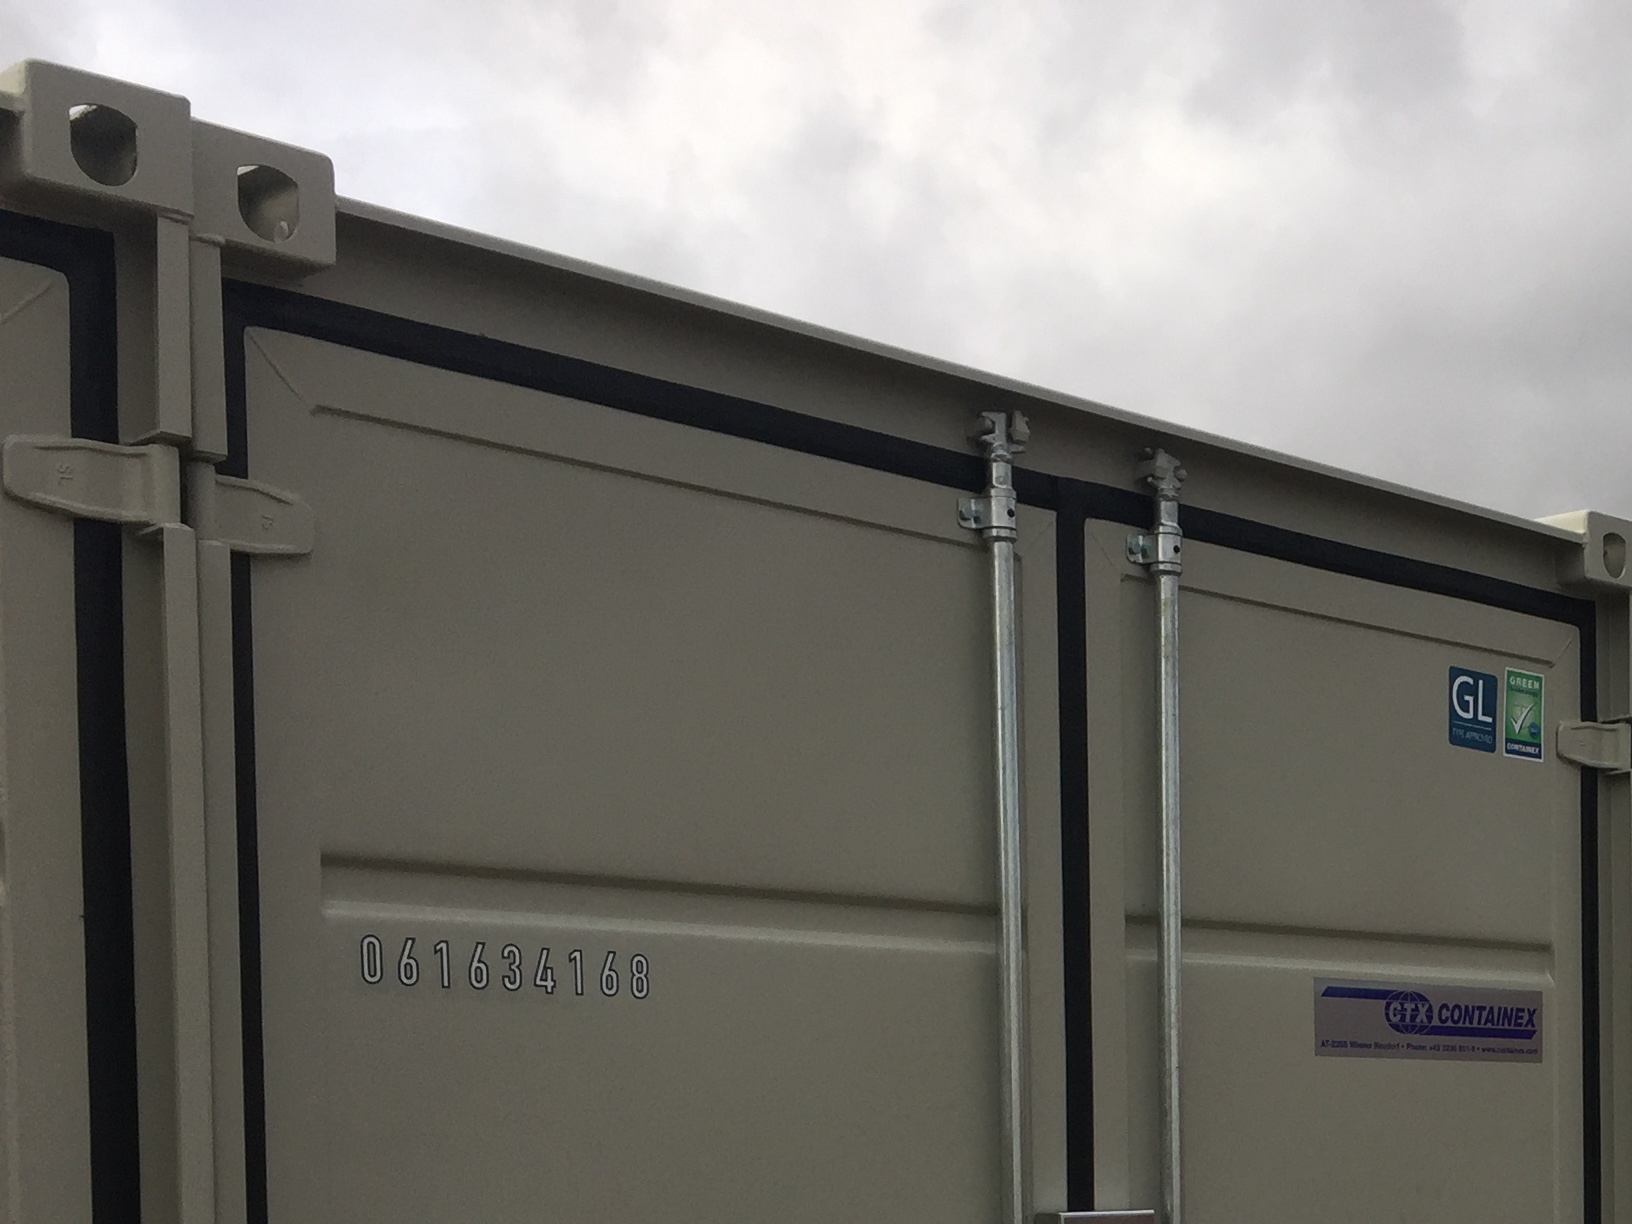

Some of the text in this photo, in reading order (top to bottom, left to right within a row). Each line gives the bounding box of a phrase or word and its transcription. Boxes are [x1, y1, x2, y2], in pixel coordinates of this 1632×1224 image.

[1452, 676, 1493, 723] GL
[1509, 676, 1540, 689] GREEN
[361, 934, 650, 999] 061634168
[1438, 1003, 1538, 1029] CONTAINEX
